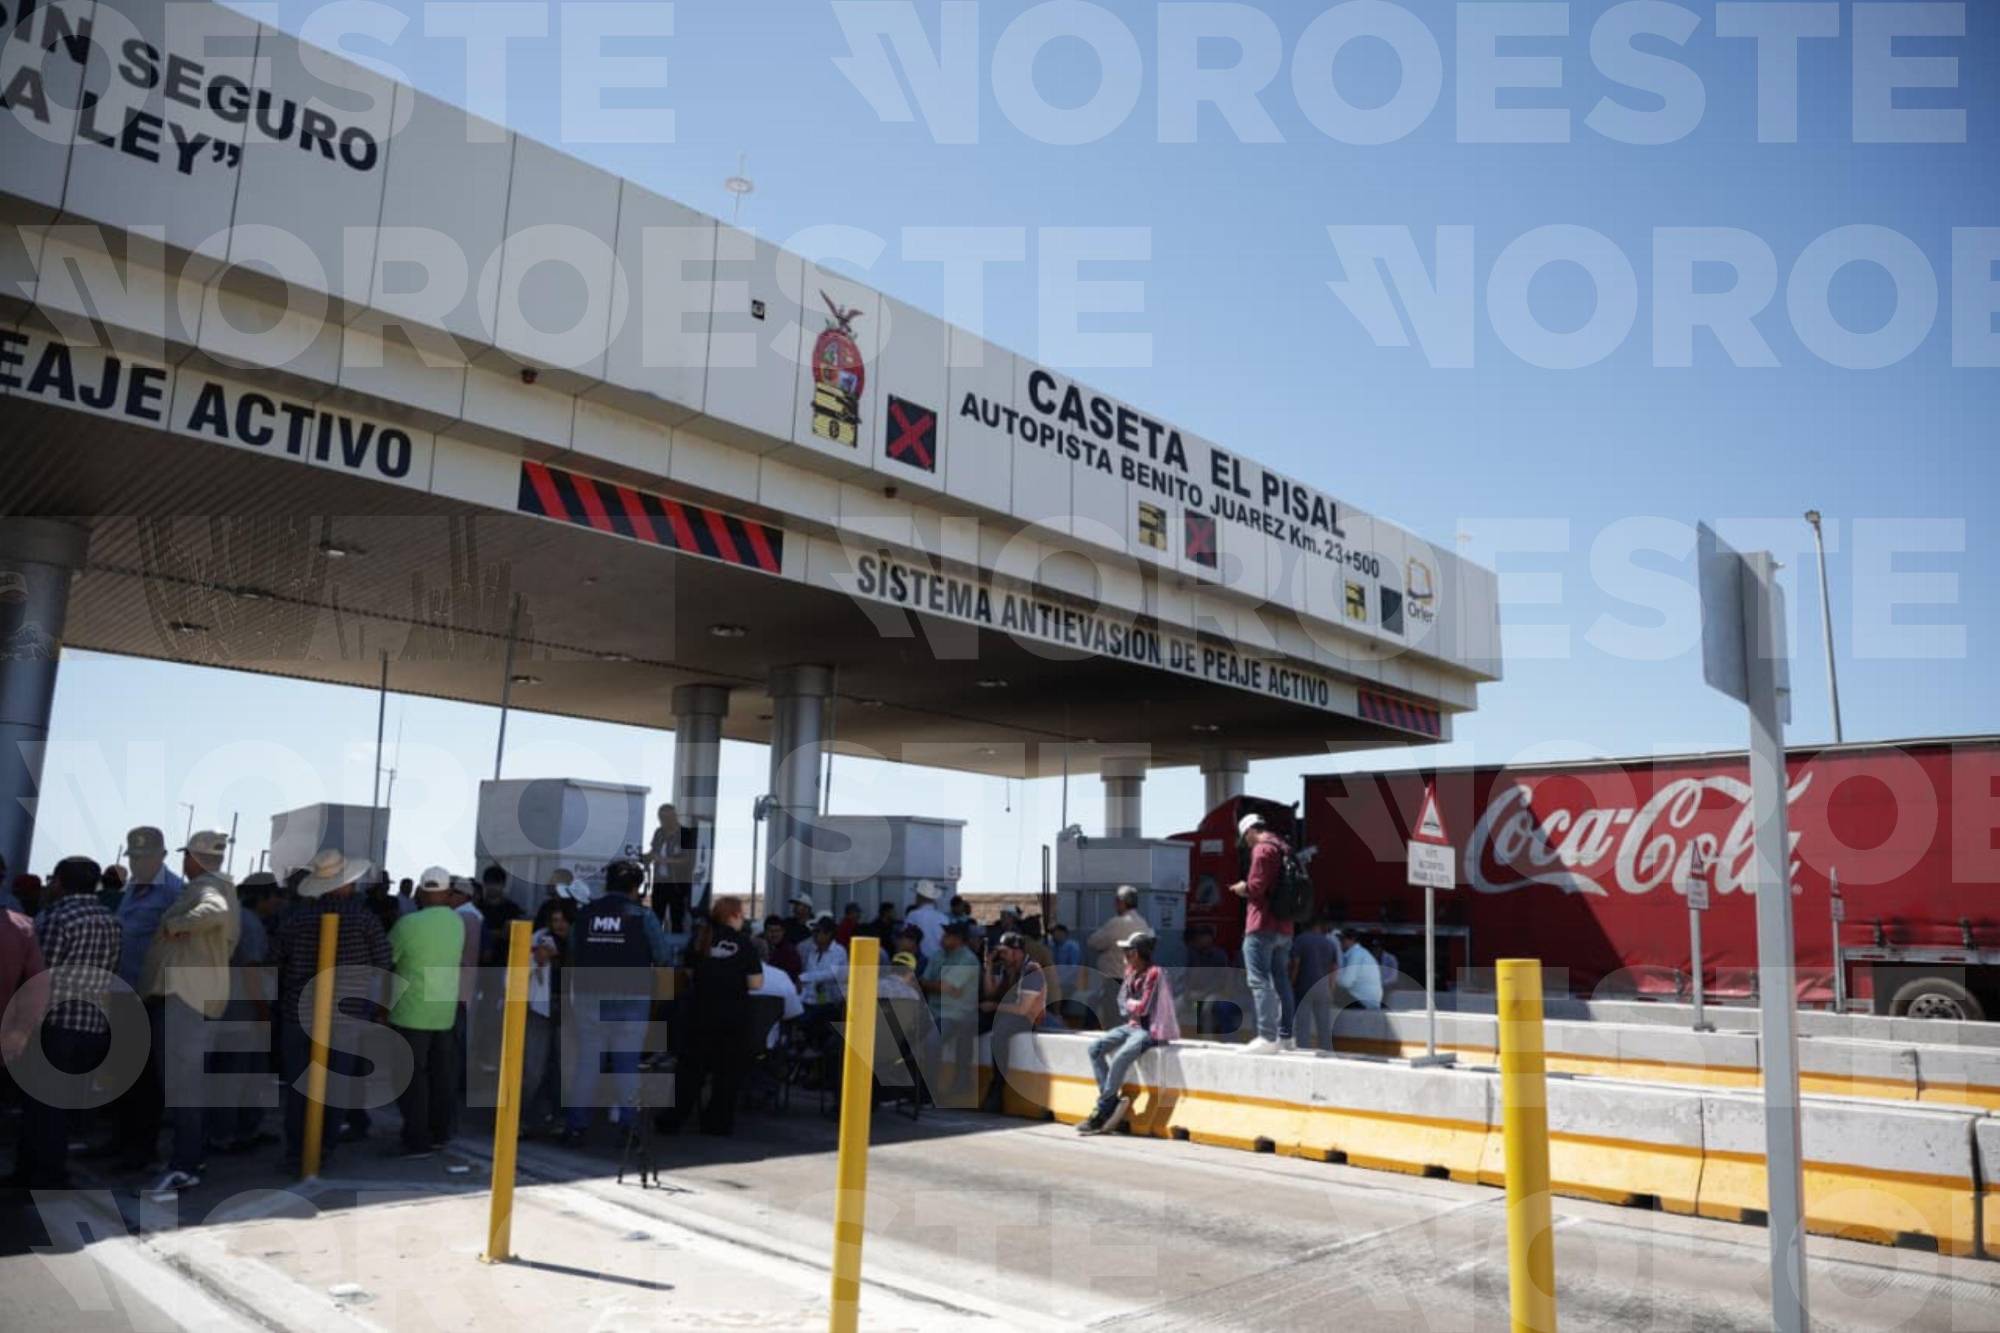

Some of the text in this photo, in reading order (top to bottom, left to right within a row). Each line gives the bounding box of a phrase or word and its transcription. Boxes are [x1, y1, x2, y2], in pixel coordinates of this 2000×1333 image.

[0, 0, 378, 172] IN SEGURO
[187, 380, 413, 479] ACTIVO
[960, 391, 1380, 579] AUTOPISTA BENITO JUAREZ Km. 23+500
[1027, 369, 1346, 539] CASETA EL PISAL
[856, 554, 1330, 708] SISTEMA ANTIEVASION DE PEAJE ACTIVO
[593, 915, 622, 932] MN
